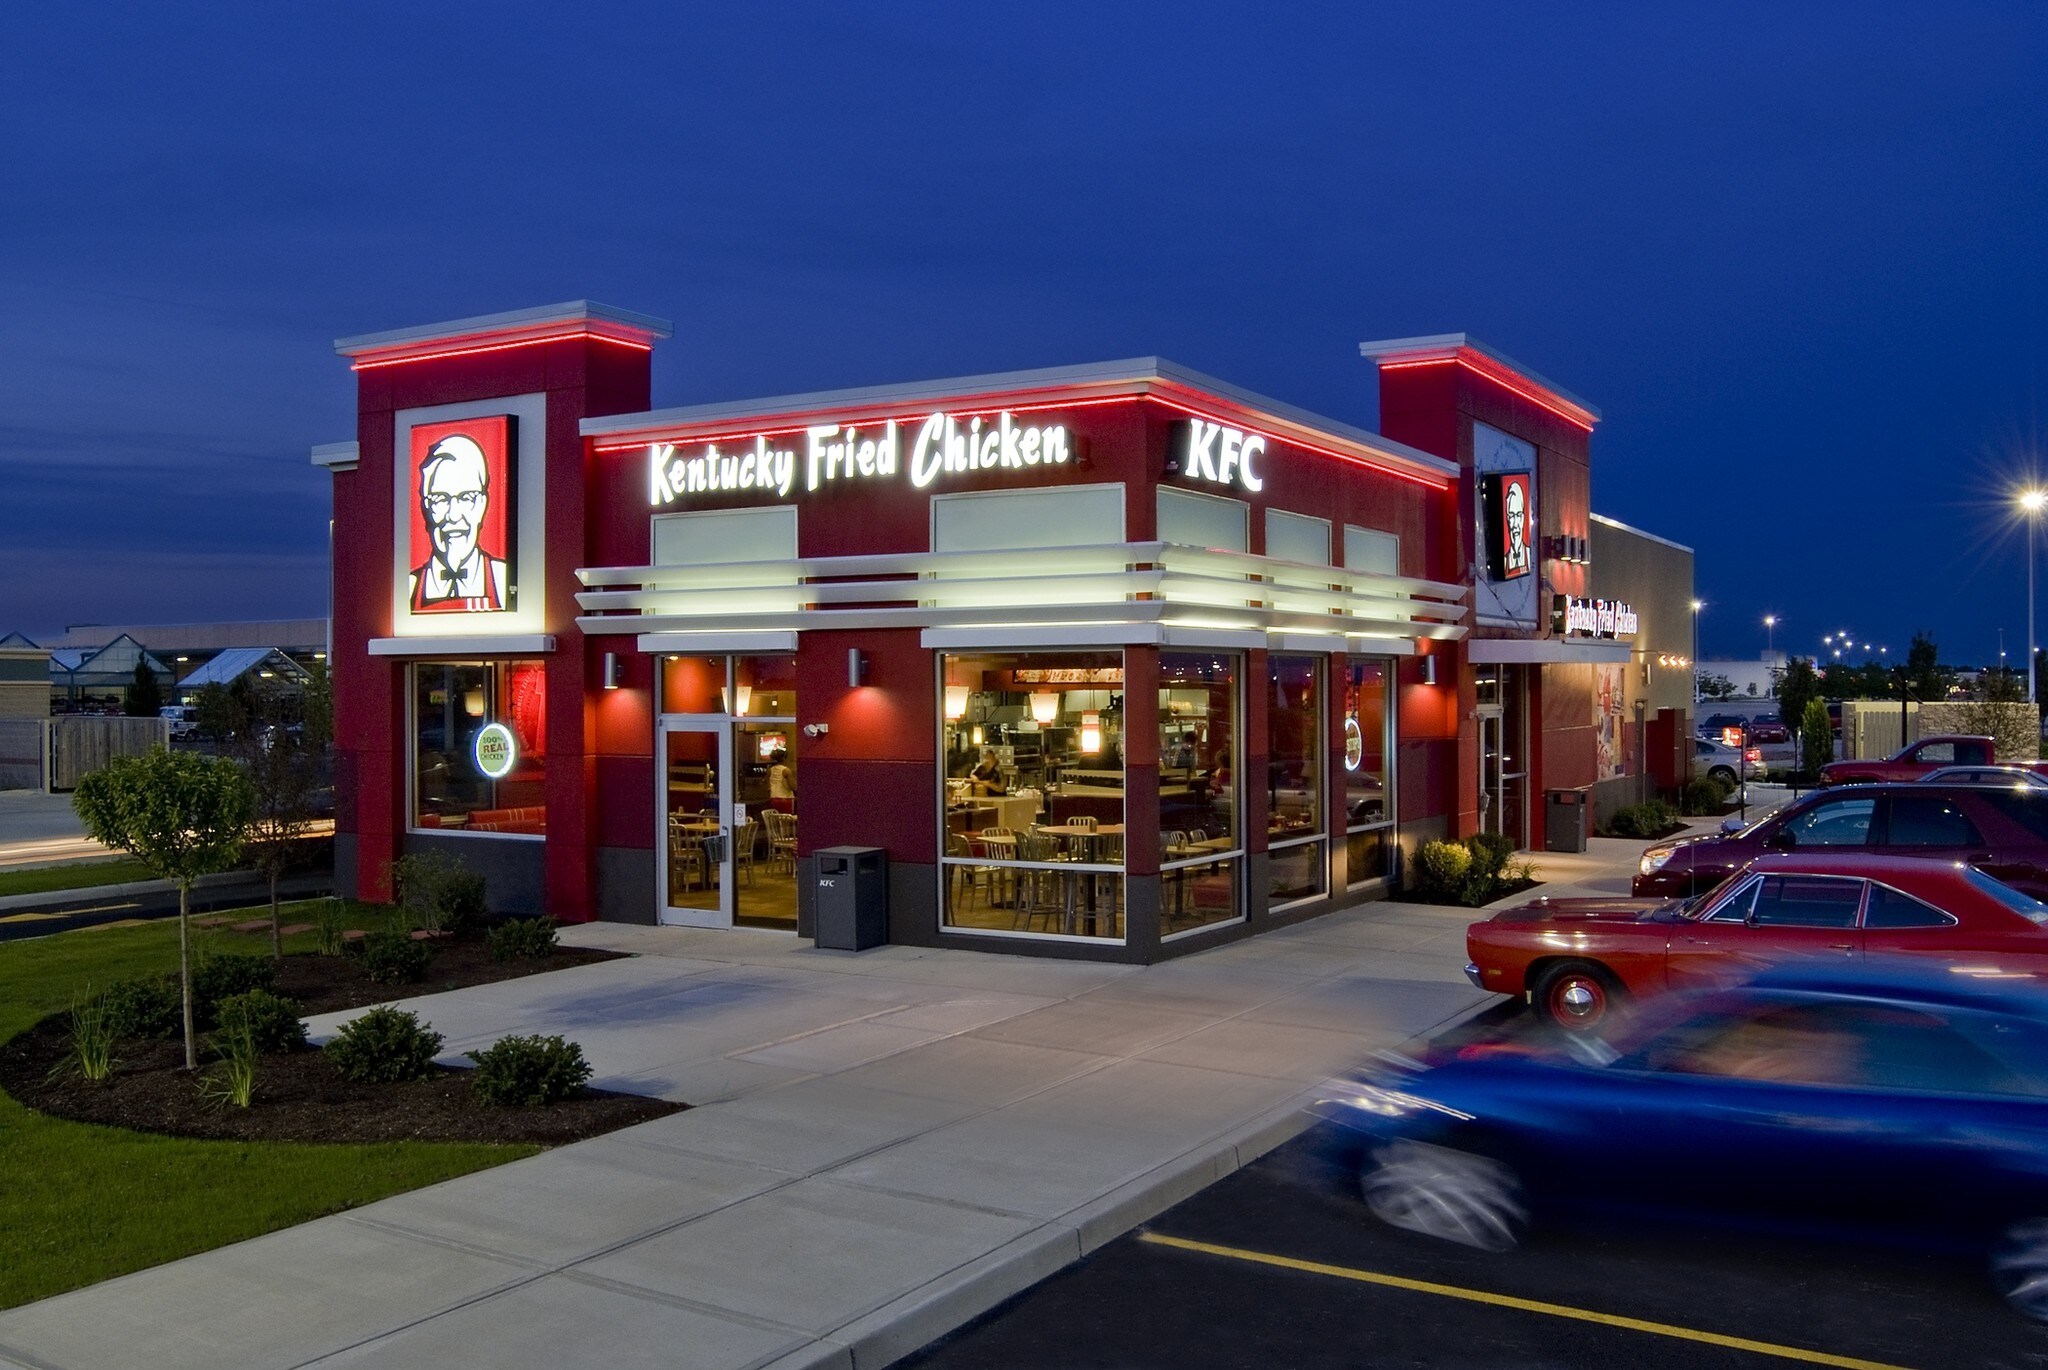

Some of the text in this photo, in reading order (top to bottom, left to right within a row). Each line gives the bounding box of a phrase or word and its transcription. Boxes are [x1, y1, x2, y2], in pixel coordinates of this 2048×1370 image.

[650, 410, 1069, 506] Kentucky Fried Chicken
[1185, 418, 1266, 492] KFC
[483, 736, 504, 744] 100%
[483, 743, 509, 753] REAL
[481, 753, 504, 761] CHICKEN
[819, 879, 835, 887] KFC
